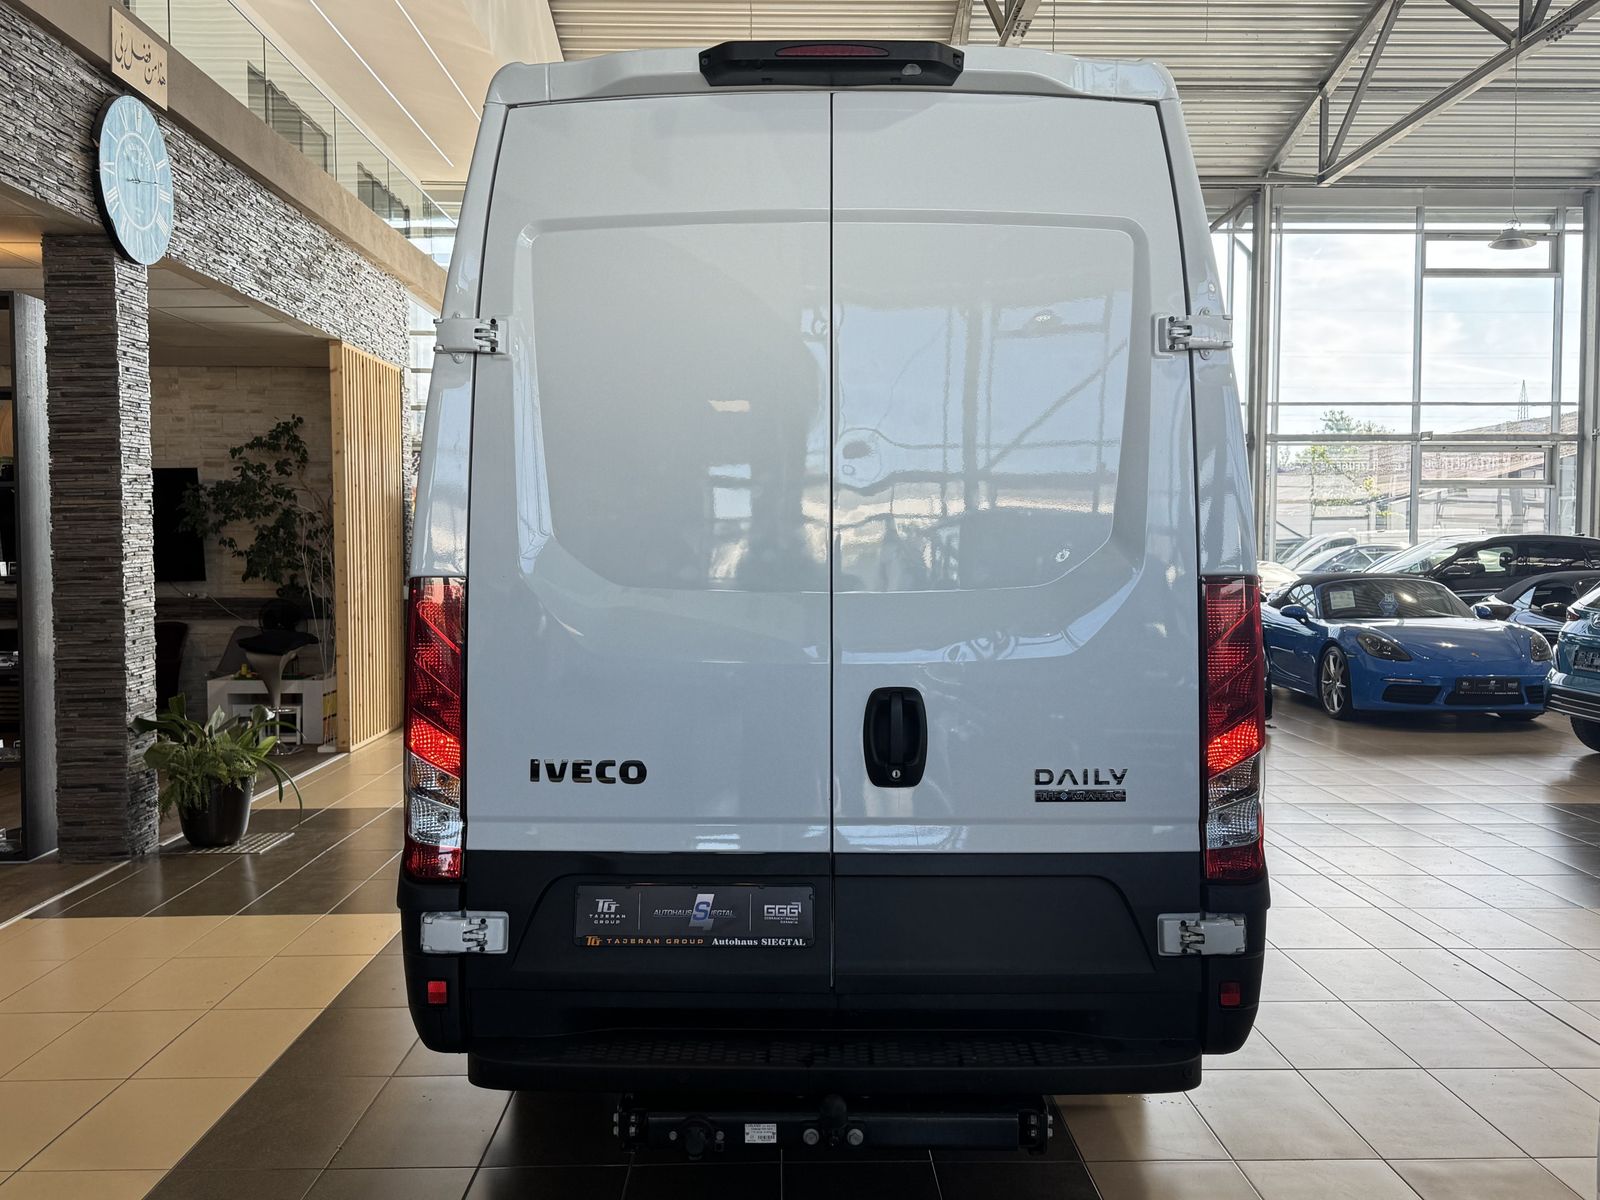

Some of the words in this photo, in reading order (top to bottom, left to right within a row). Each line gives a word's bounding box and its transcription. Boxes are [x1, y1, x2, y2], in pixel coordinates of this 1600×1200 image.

[529, 758, 648, 785] IVECO
[1034, 768, 1128, 785] DAILY
[711, 937, 758, 946] Autohaus
[761, 937, 806, 946] SIEGTAL
